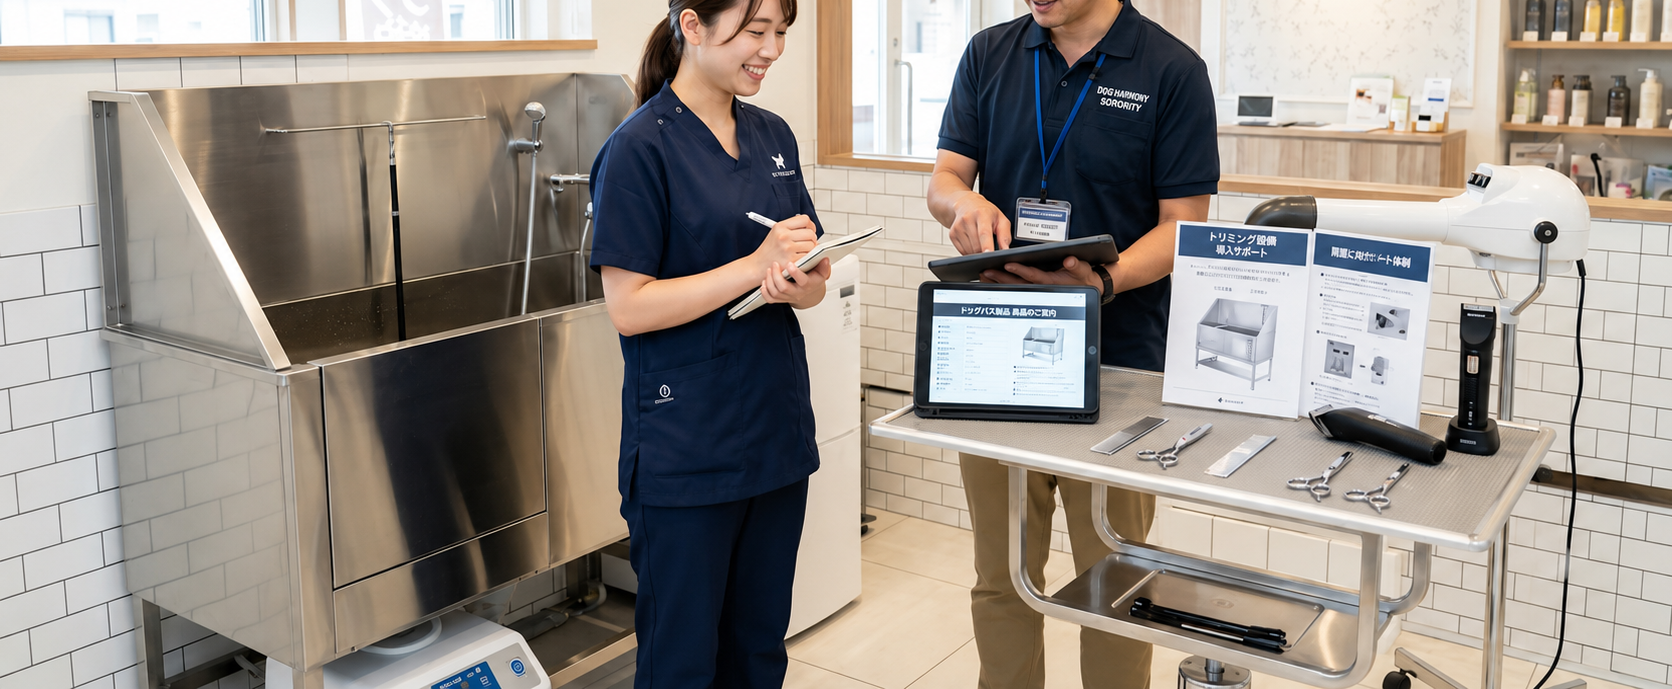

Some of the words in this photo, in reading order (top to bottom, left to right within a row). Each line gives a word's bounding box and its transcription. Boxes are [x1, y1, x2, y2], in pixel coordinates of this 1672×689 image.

[1097, 86, 1114, 96] DOG
[1114, 89, 1149, 103] HARMONY
[1100, 97, 1142, 112] SORORITY
